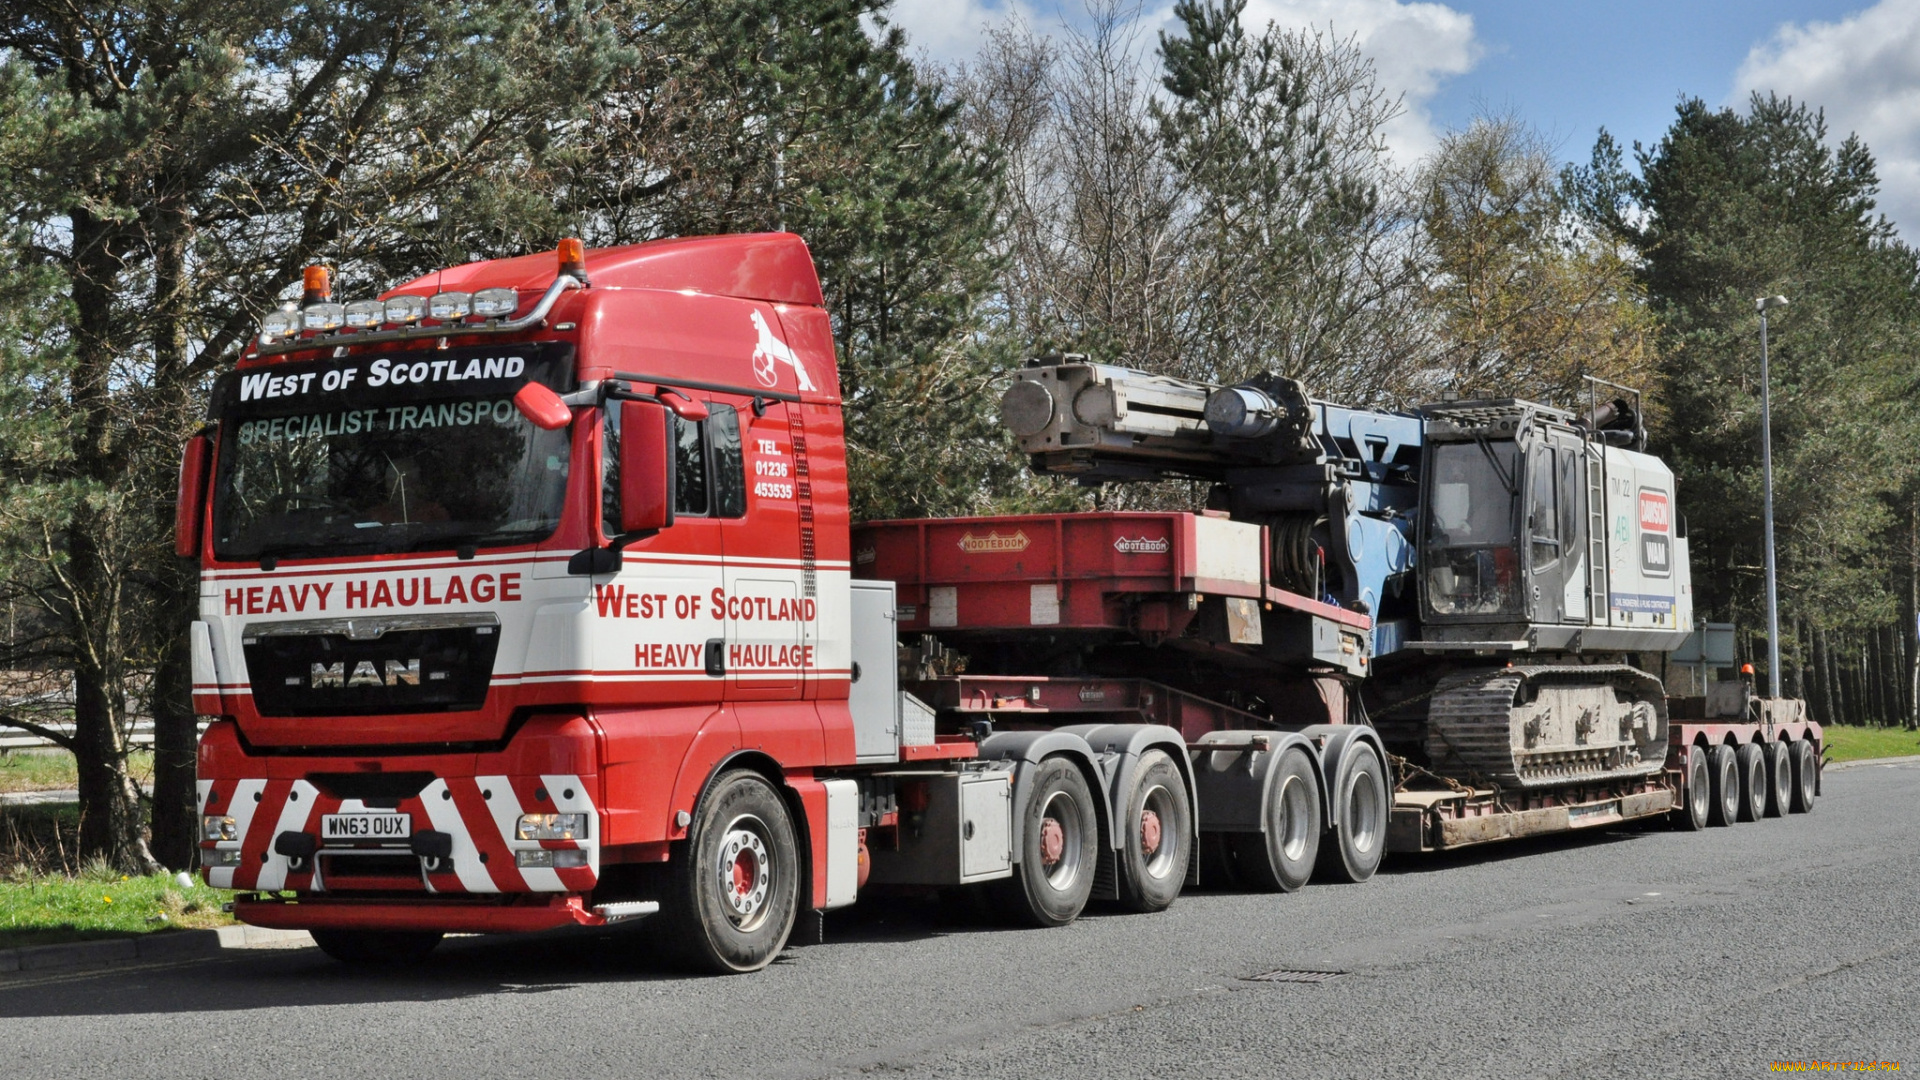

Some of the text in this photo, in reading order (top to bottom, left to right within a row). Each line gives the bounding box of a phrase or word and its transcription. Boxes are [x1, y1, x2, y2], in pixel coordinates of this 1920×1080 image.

[240, 399, 521, 445] SPECIALIST TRANSPO
[757, 439, 782, 456] TEL.
[755, 461, 788, 477] 01236
[754, 481, 793, 499] 453535
[1641, 500, 1668, 525] DAWSON
[963, 538, 1024, 549] NOOTEBOOM
[1118, 541, 1167, 551] NOOTEBOOM
[224, 573, 523, 616] HEAVY HAULAGE
[635, 643, 814, 668] HEAVY HAULAGE
[311, 659, 421, 689] MAN
[329, 817, 403, 835] WN63 OUX
